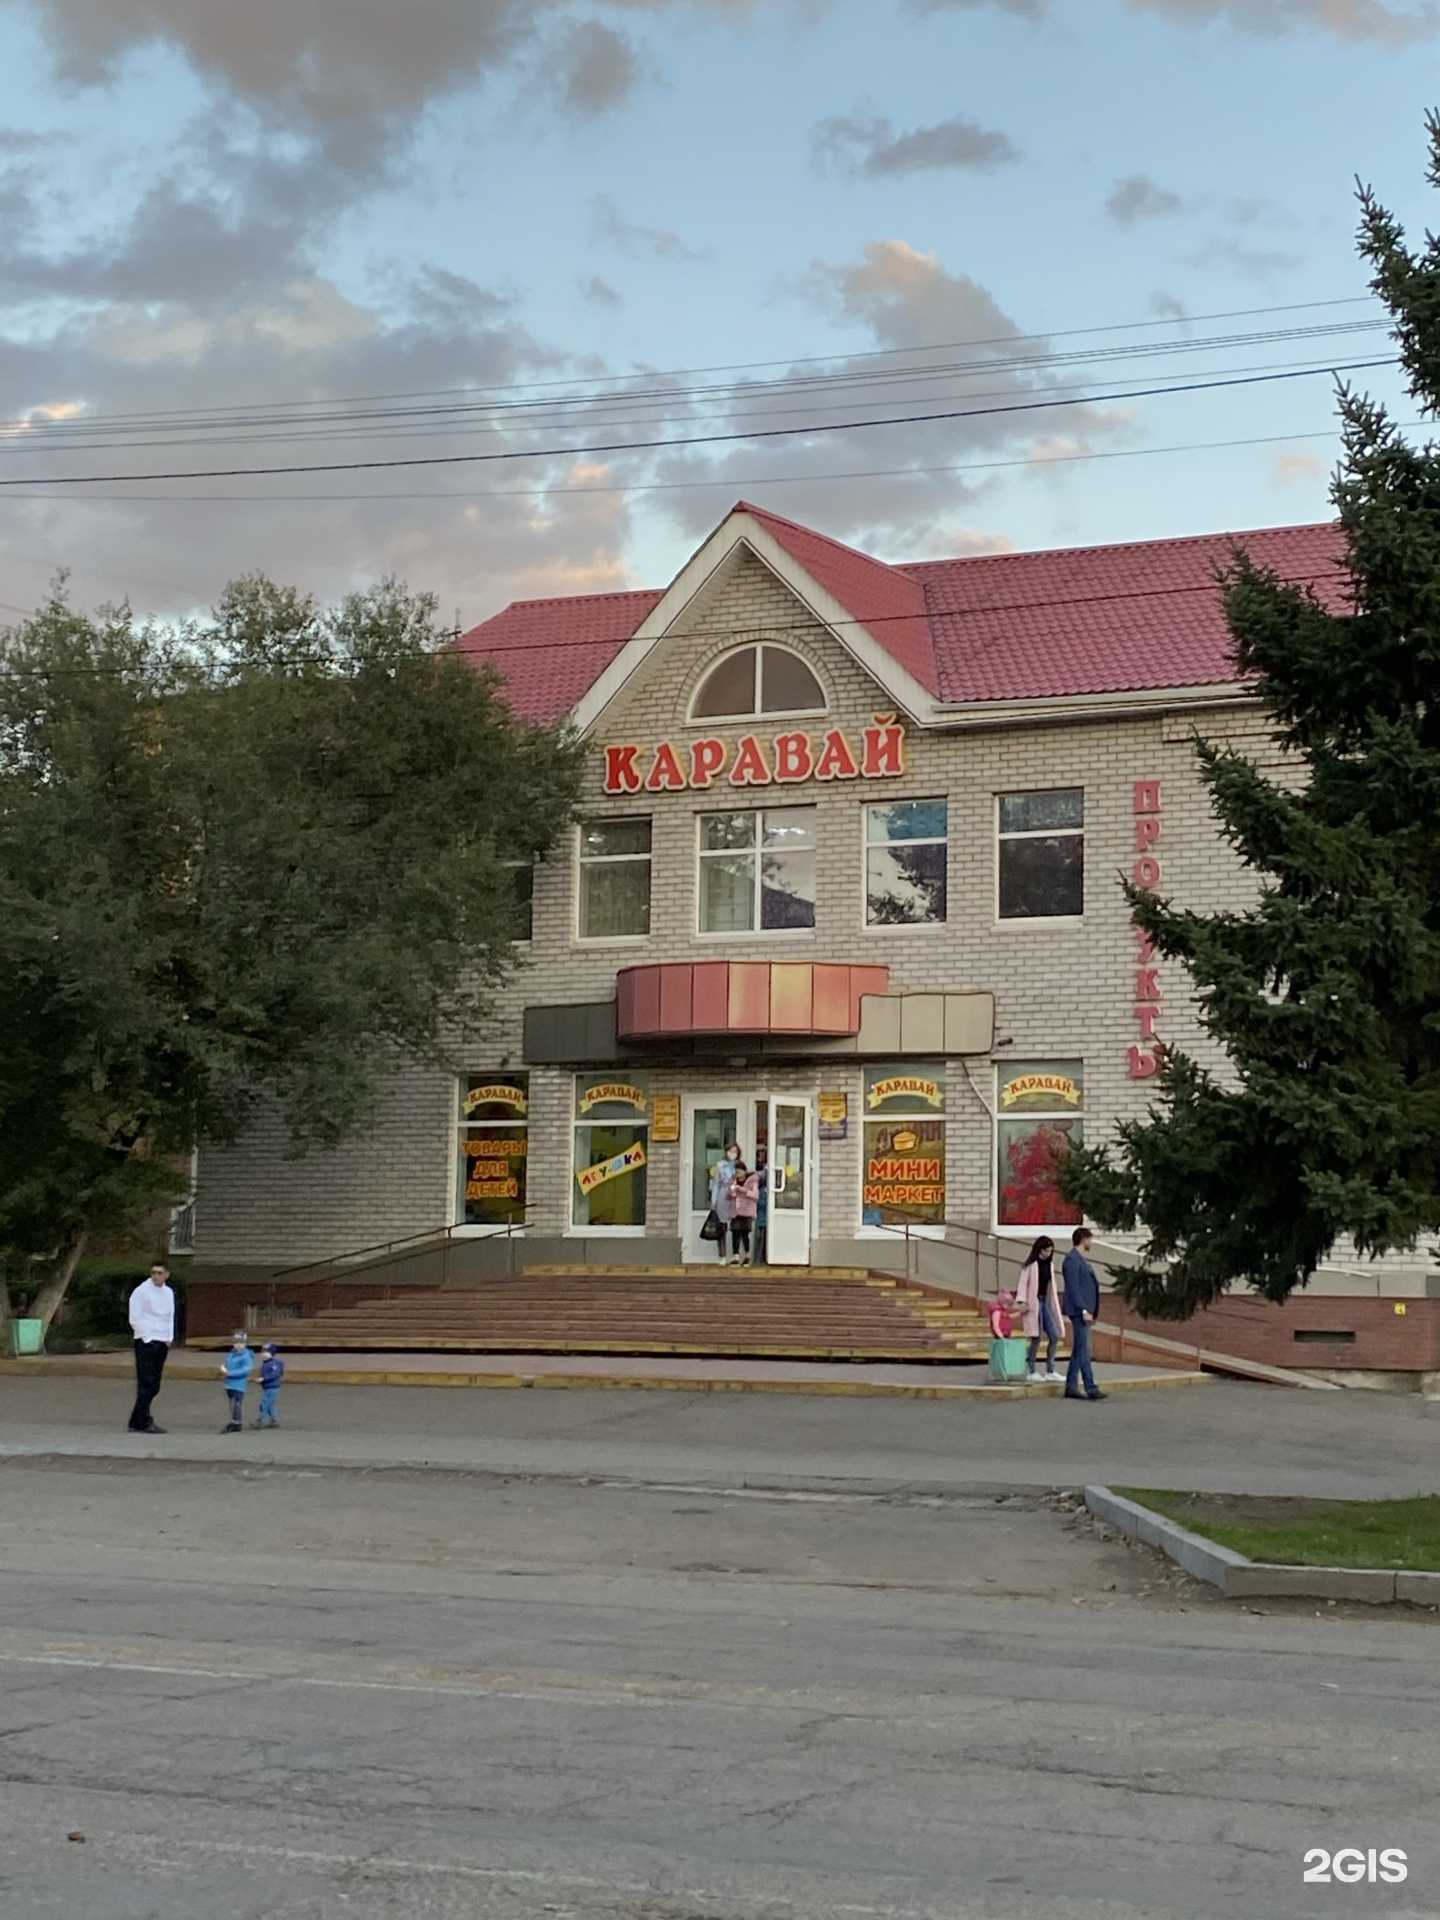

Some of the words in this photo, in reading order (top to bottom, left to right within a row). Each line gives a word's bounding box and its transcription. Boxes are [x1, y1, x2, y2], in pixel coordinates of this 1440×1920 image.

[604, 713, 905, 794] КАРАВАЙ
[1126, 779, 1168, 1080] ПРОУКТЫ
[864, 1184, 944, 1204] МАРКЕТ
[868, 1158, 940, 1181] МИНИ
